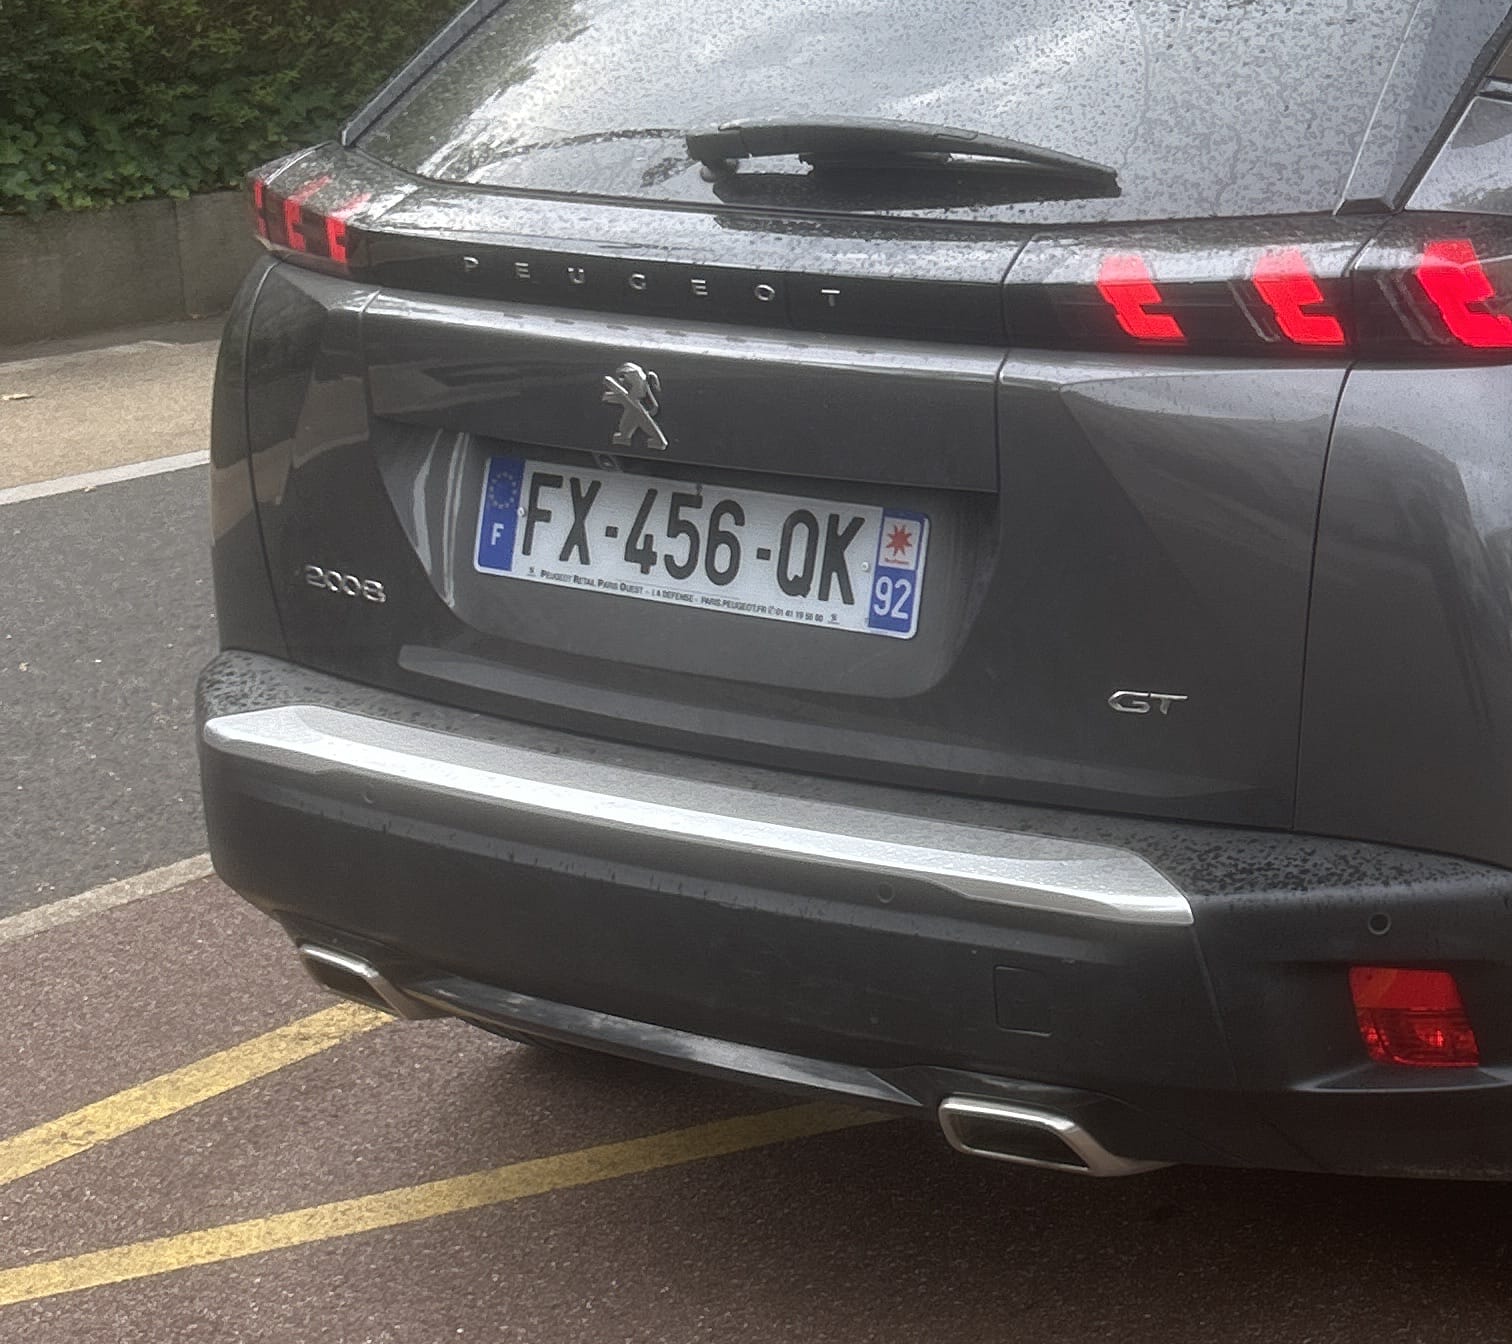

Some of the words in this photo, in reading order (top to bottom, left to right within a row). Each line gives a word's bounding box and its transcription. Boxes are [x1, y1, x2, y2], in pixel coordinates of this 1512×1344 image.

[463, 256, 841, 308] PEUGEOT
[491, 522, 504, 545] F
[522, 472, 865, 605] FX-456-QK
[304, 564, 387, 603] 2008
[873, 576, 912, 620] 92
[1108, 690, 1188, 715] GT
